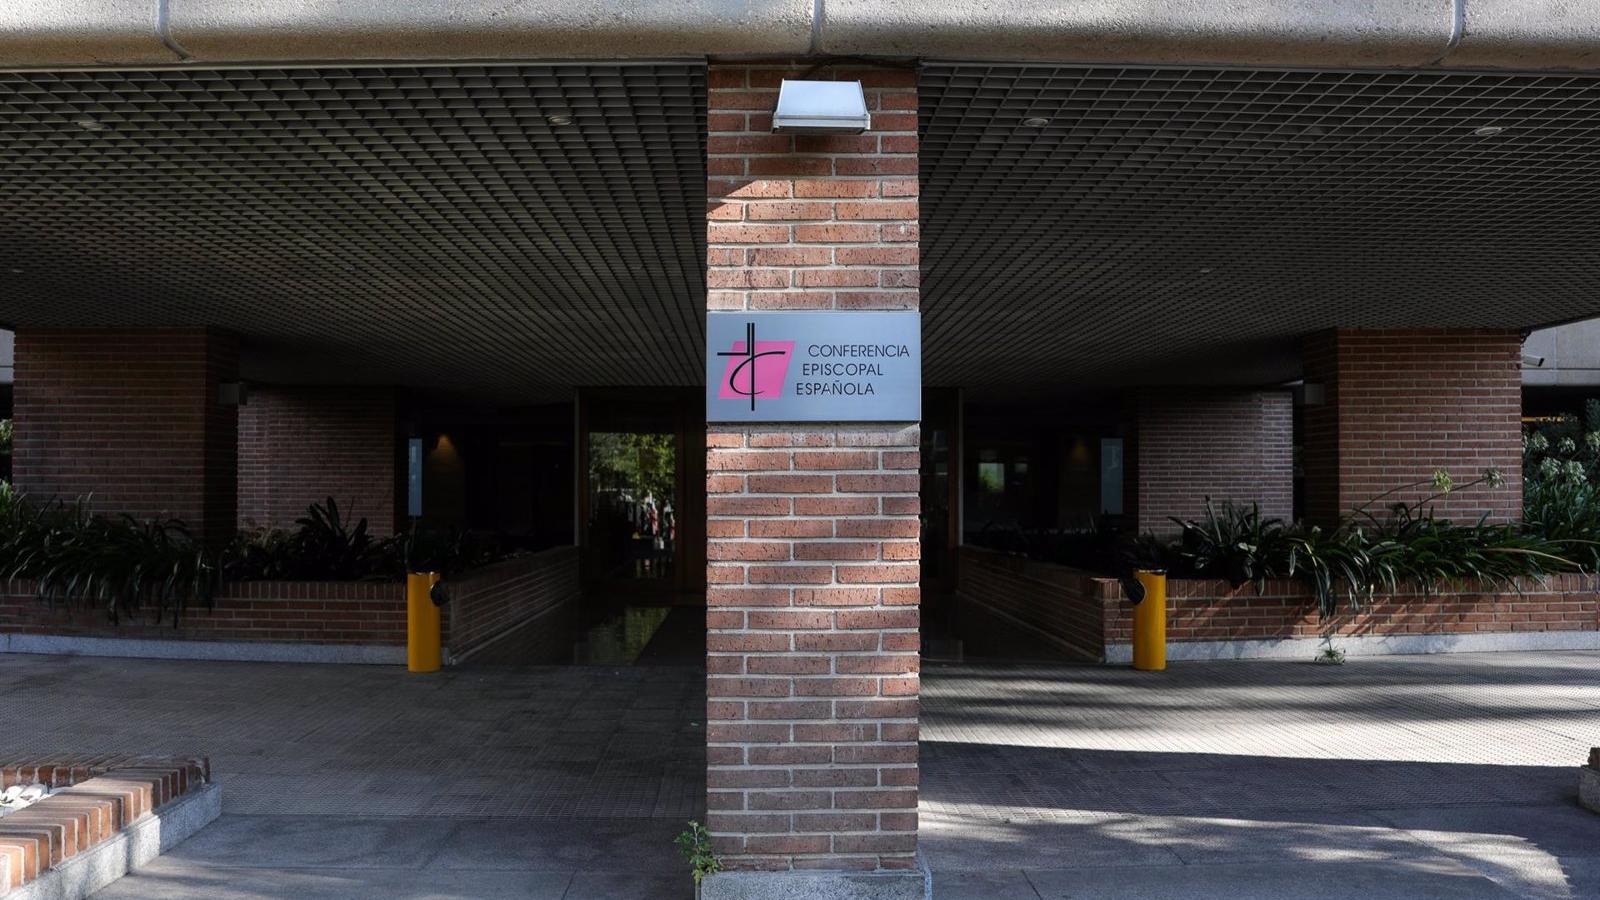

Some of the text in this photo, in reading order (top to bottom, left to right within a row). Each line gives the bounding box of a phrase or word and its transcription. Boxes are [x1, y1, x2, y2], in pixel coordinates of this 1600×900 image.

[808, 344, 910, 358] CONFERENCIA
[802, 363, 884, 376] EPISCOPAL
[796, 380, 875, 396] ESPAÑOLA
